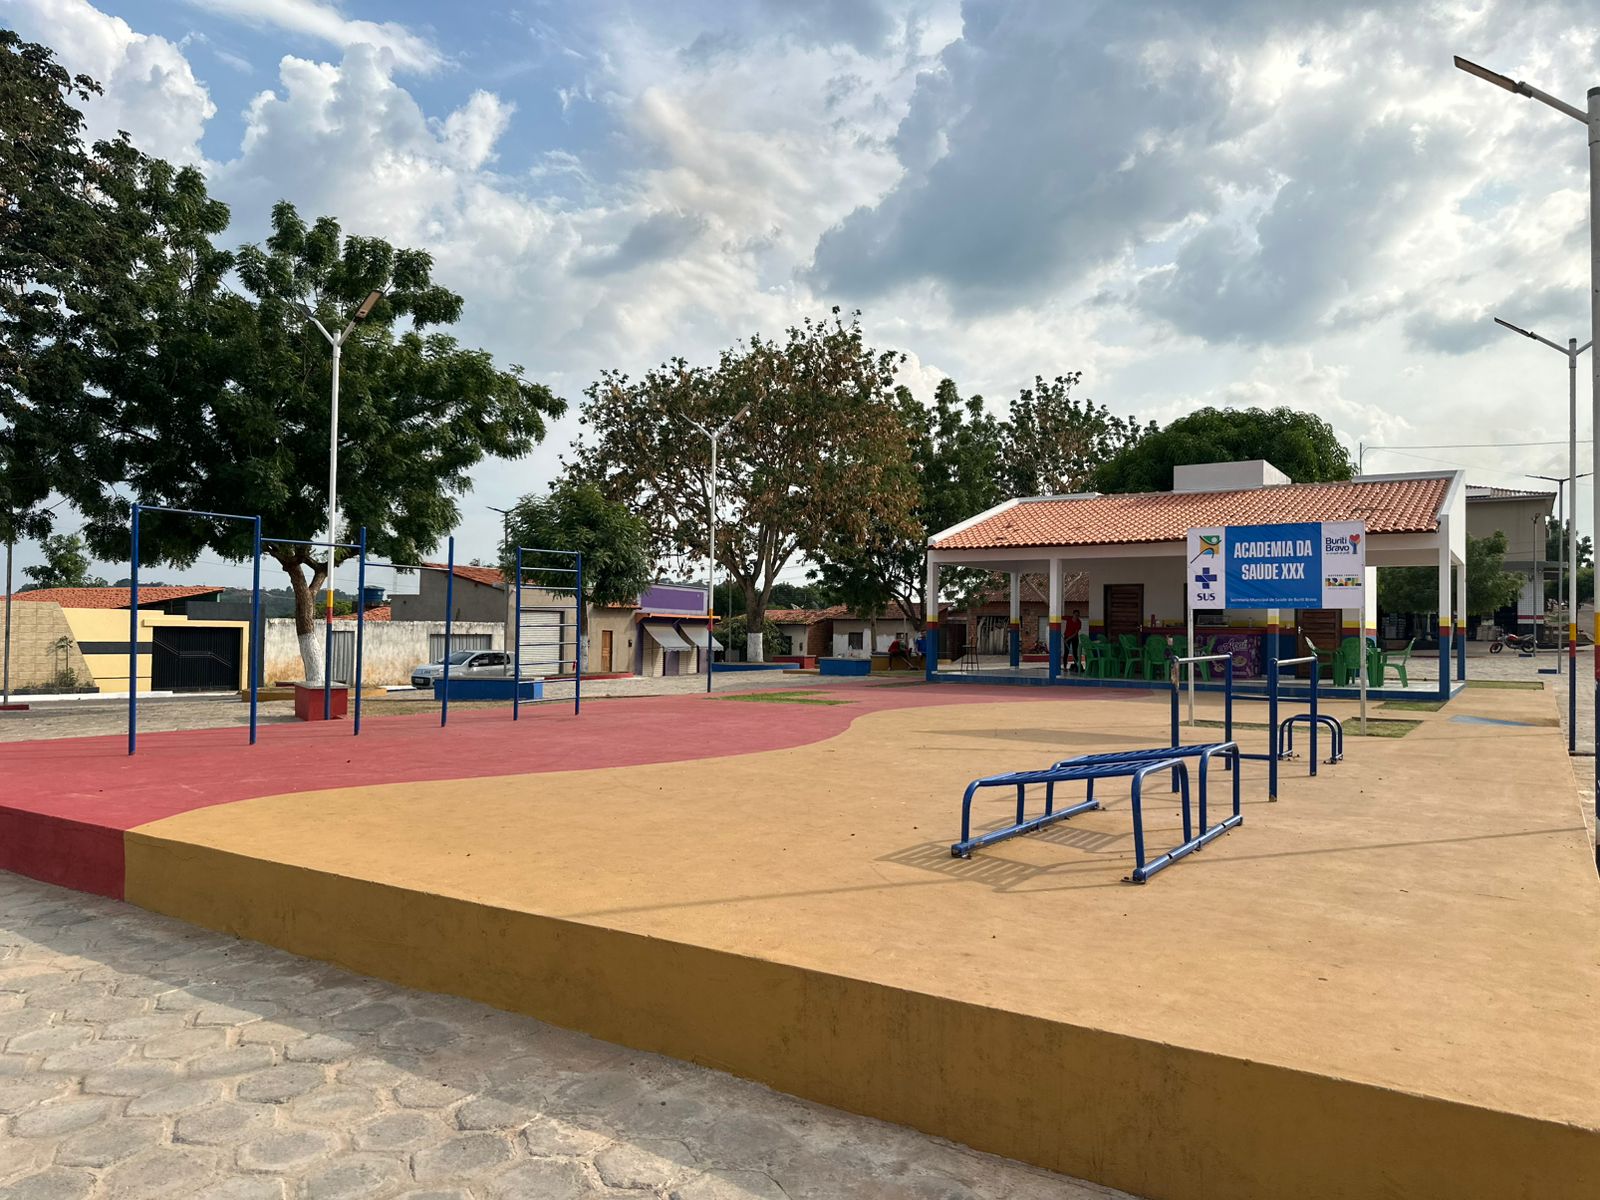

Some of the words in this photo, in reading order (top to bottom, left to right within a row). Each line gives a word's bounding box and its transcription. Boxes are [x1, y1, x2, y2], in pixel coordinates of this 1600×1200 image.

[1326, 536, 1348, 544] Buriti
[1234, 540, 1294, 558] ACADEMIA
[1296, 540, 1312, 556] DA
[1241, 562, 1279, 580] SAÚDE
[1281, 562, 1305, 580] XXX
[1196, 592, 1216, 601] SUS
